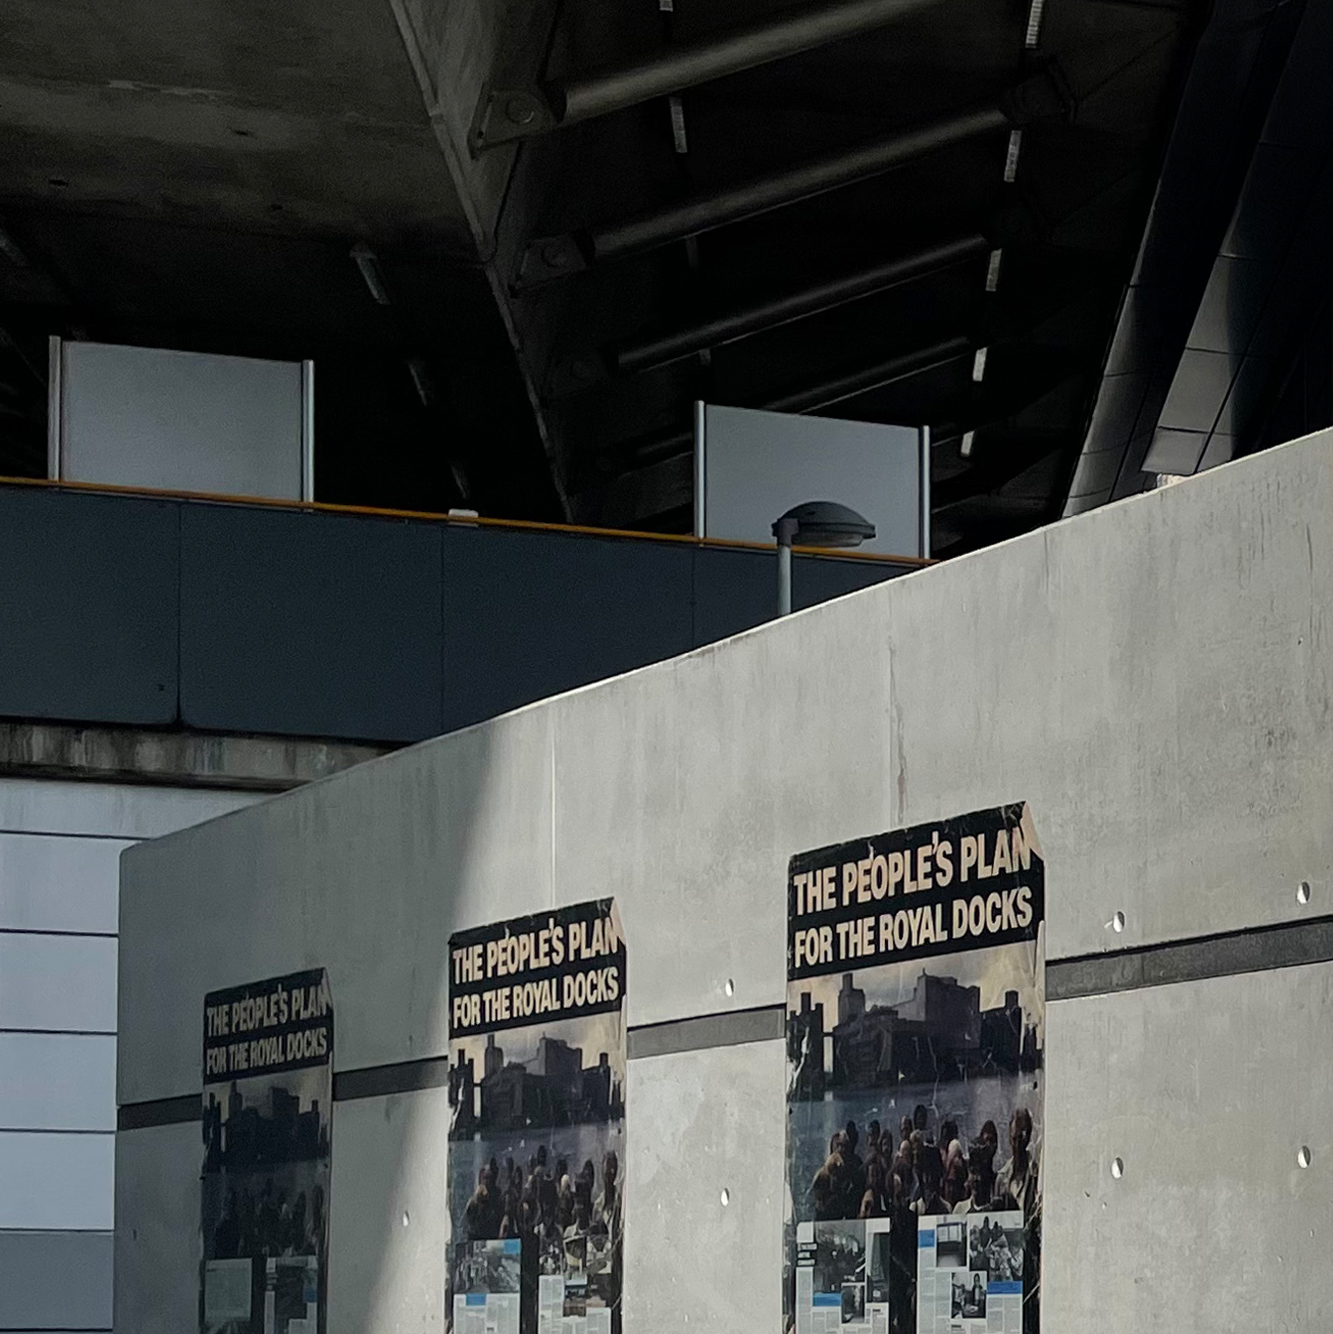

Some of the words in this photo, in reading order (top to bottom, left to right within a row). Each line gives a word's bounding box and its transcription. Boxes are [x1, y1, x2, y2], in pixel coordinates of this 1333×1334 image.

[793, 866, 837, 916] THE
[842, 831, 954, 907] PEOPLE'S
[960, 826, 1031, 882] PLAN
[452, 943, 484, 985] THE
[486, 918, 564, 978] PEOPLE'S
[568, 916, 618, 962] PLAN
[794, 925, 833, 968] FOR
[836, 916, 875, 960] THE
[879, 903, 948, 952] ROYAL
[952, 885, 1033, 939] DOCKS
[206, 1004, 229, 1038] THE
[453, 993, 481, 1029] FOR
[483, 986, 511, 1023] THE
[513, 977, 561, 1018] ROYAL
[563, 966, 619, 1009] DOCKS
[206, 1046, 227, 1075] FOR
[228, 1041, 249, 1071] THE
[250, 1035, 285, 1068] ROYAL
[287, 1027, 327, 1061] DOCKS
